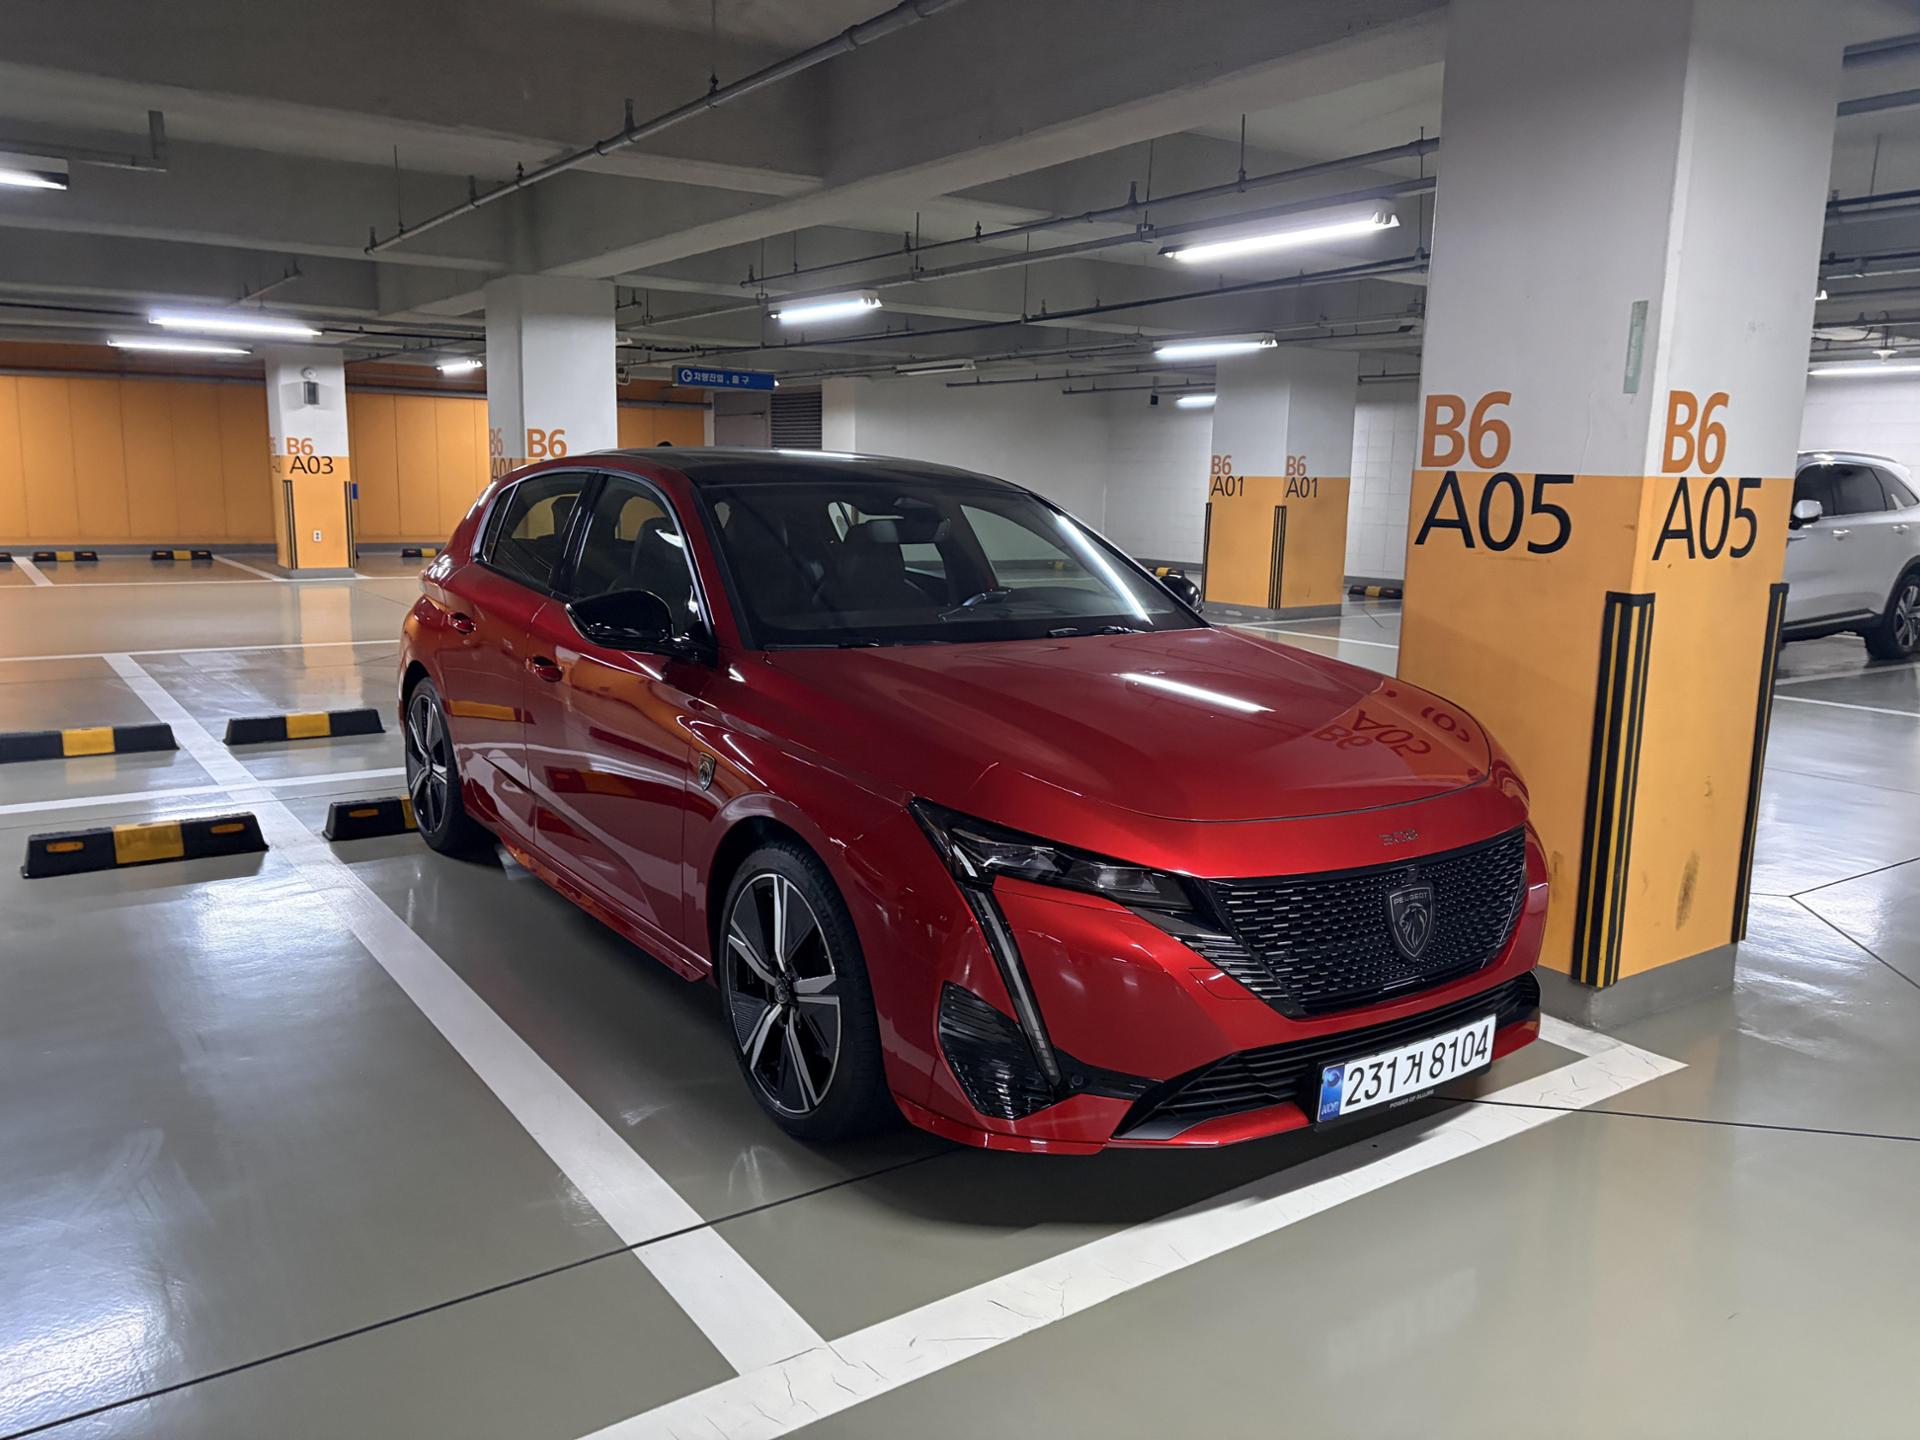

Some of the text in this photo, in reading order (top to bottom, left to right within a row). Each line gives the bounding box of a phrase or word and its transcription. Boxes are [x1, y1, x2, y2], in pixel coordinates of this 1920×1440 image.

[490, 428, 503, 457] B6
[1420, 390, 1512, 470] B6
[1661, 390, 1730, 474] B6
[286, 437, 314, 456] B6
[527, 428, 568, 459] B6
[289, 455, 334, 474] A03
[1211, 455, 1232, 475] B6
[1286, 455, 1306, 476] B6
[1210, 475, 1244, 497] A01
[1285, 476, 1319, 498] A01
[1414, 470, 1575, 555] A05
[1652, 476, 1762, 561] A05
[1393, 892, 1428, 905] PEUGEOT
[1429, 1023, 1489, 1080] 8104
